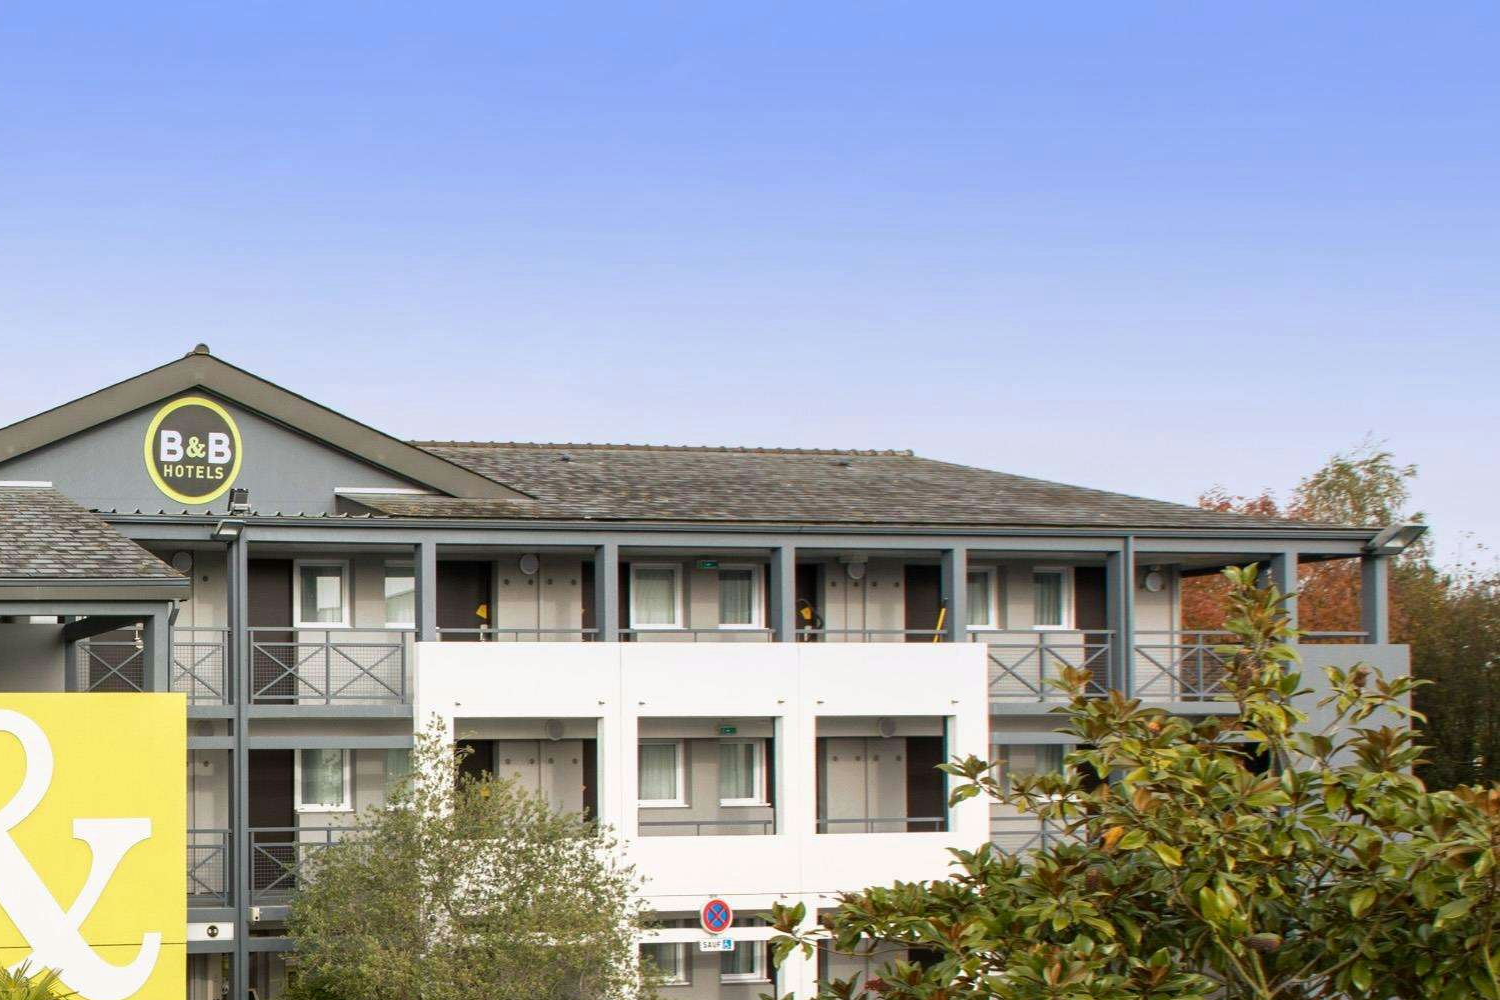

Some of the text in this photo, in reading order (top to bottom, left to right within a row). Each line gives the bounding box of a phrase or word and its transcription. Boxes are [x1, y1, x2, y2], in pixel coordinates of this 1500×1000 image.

[160, 430, 231, 464] B&B
[163, 465, 224, 479] HOTELS
[702, 941, 721, 949] SAUF
